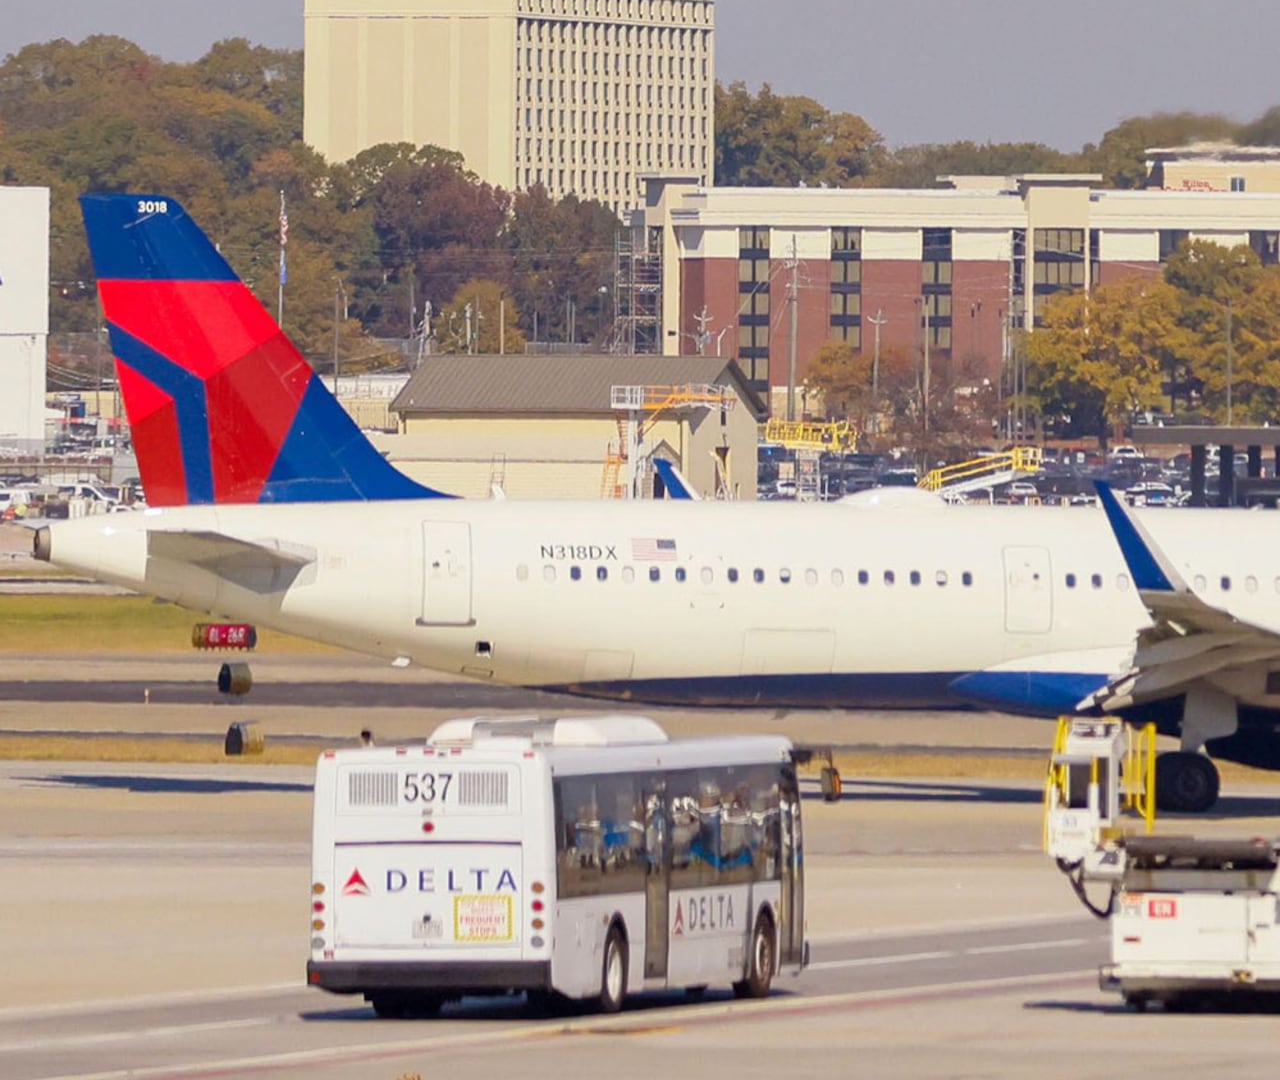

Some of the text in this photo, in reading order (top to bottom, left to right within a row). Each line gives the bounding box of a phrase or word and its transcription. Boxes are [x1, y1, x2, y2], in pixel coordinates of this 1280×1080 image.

[138, 201, 167, 213] 3018
[540, 545, 617, 560] N318DX
[404, 773, 453, 802] 537
[386, 869, 518, 892] DELTA
[689, 894, 734, 932] DELTA
